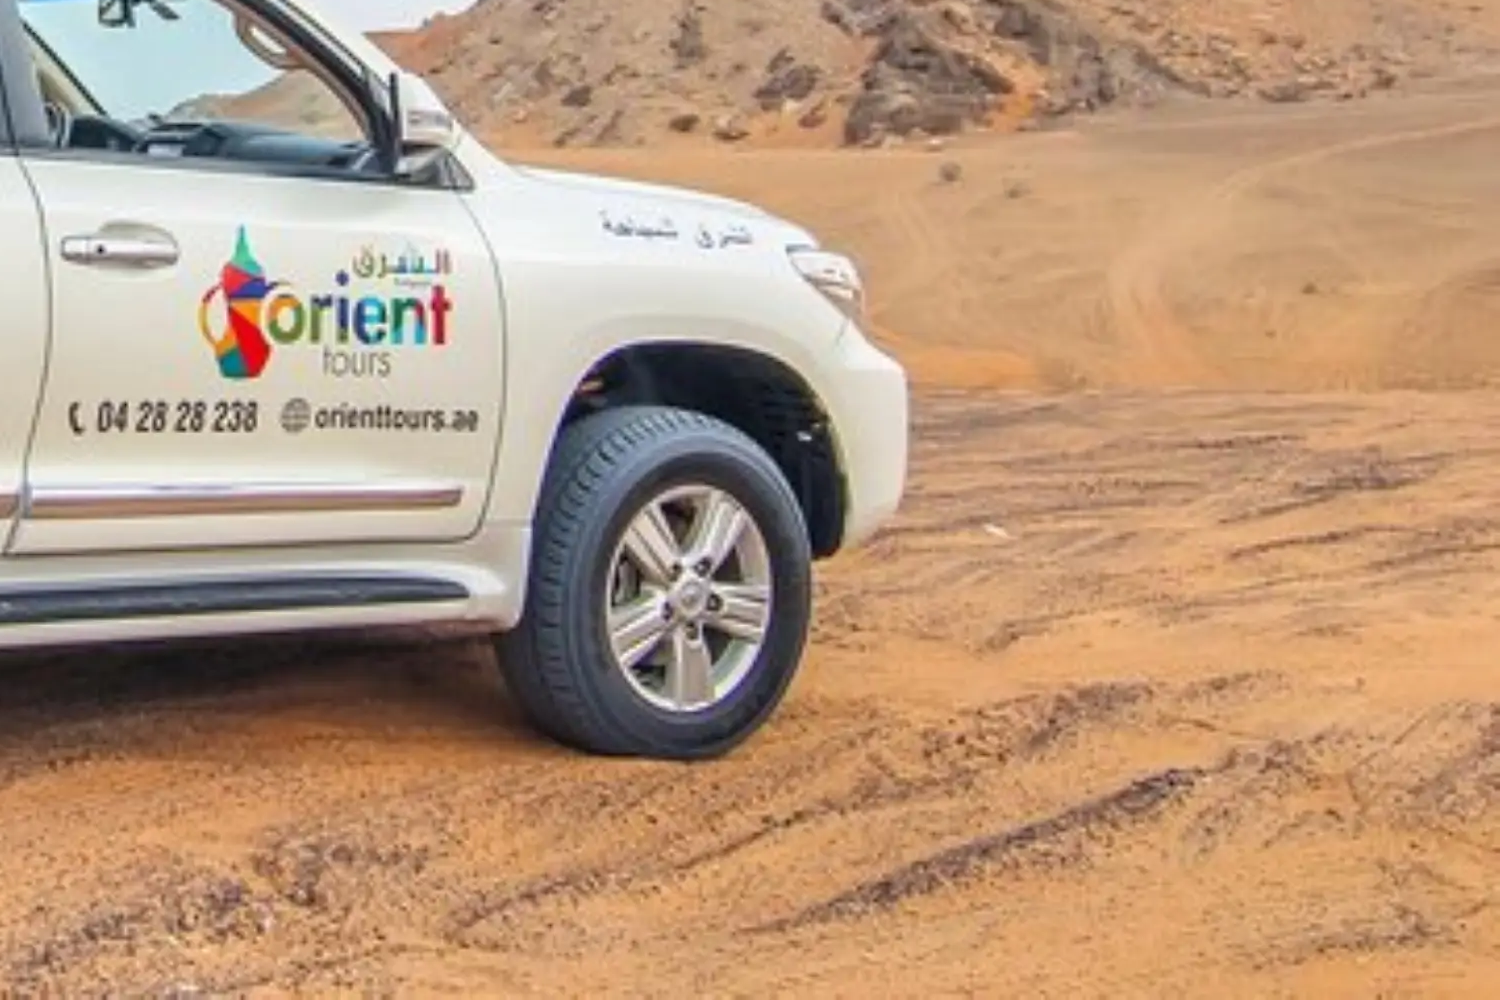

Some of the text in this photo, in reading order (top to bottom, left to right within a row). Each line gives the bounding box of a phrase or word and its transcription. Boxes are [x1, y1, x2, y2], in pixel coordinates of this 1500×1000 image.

[268, 269, 453, 345] orient
[322, 343, 392, 378] tours
[97, 400, 258, 433] 04 28 28 238
[314, 401, 479, 433] orienttours.ae
